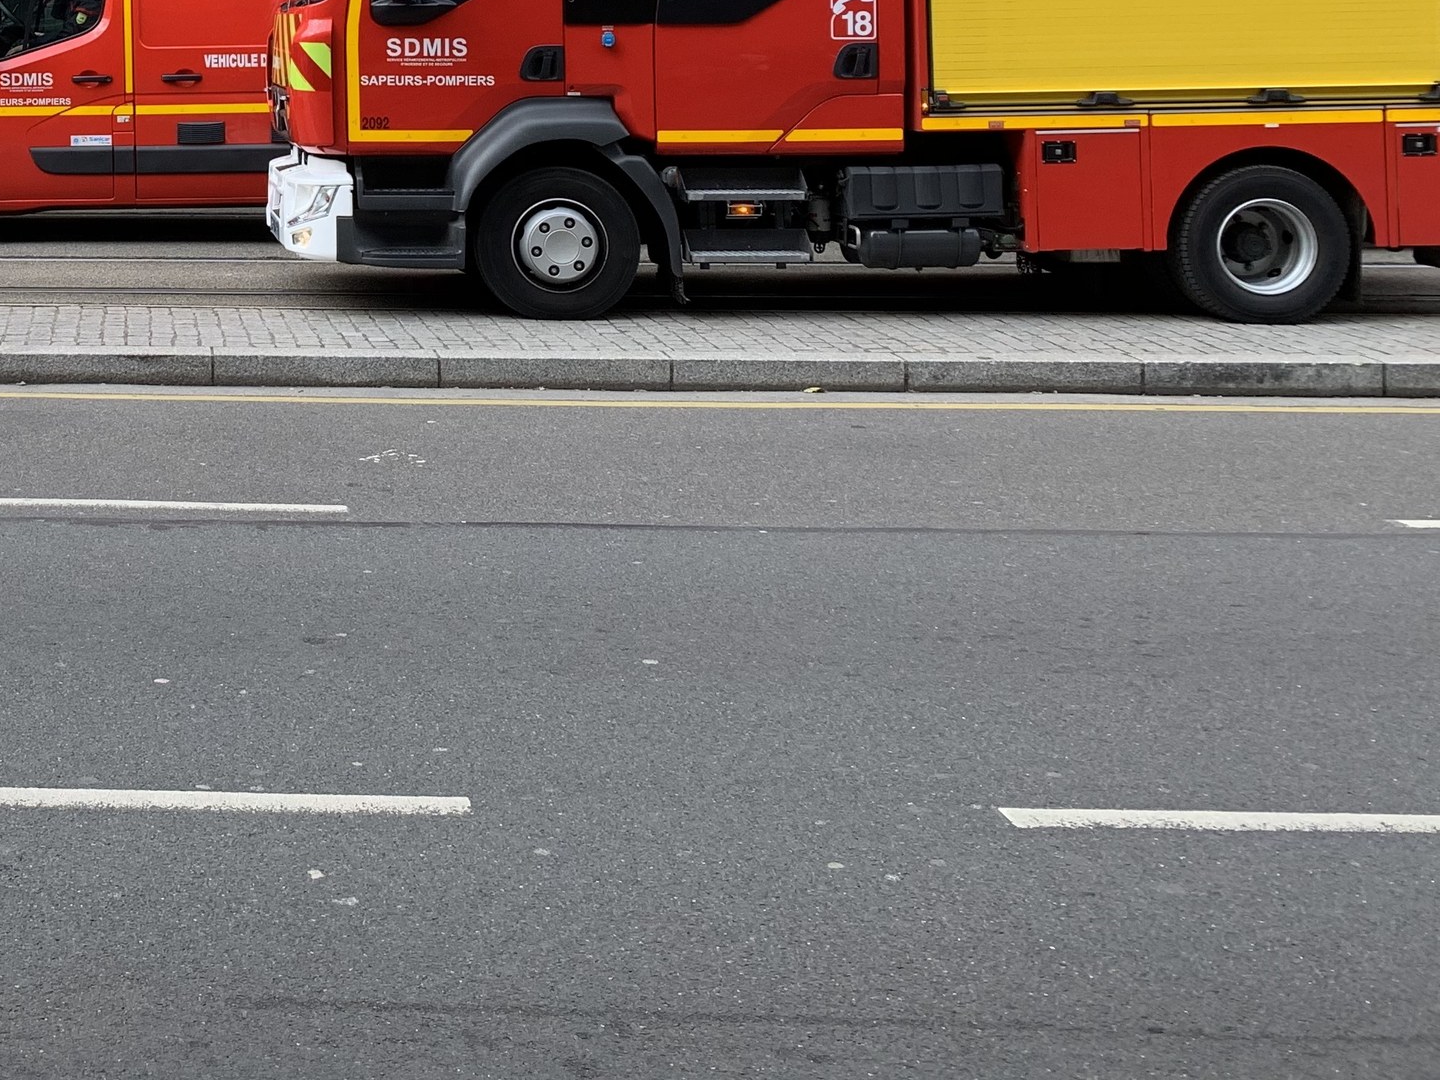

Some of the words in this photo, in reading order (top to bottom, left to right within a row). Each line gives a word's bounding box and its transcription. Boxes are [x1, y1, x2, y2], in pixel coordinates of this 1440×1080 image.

[842, 10, 872, 36] 18
[386, 38, 468, 57] SDMIS
[204, 54, 258, 68] VEHICULE
[0, 73, 54, 86] SDMIS
[360, 76, 495, 86] SAPEURS-POMPIERS
[362, 117, 390, 130] 2092
